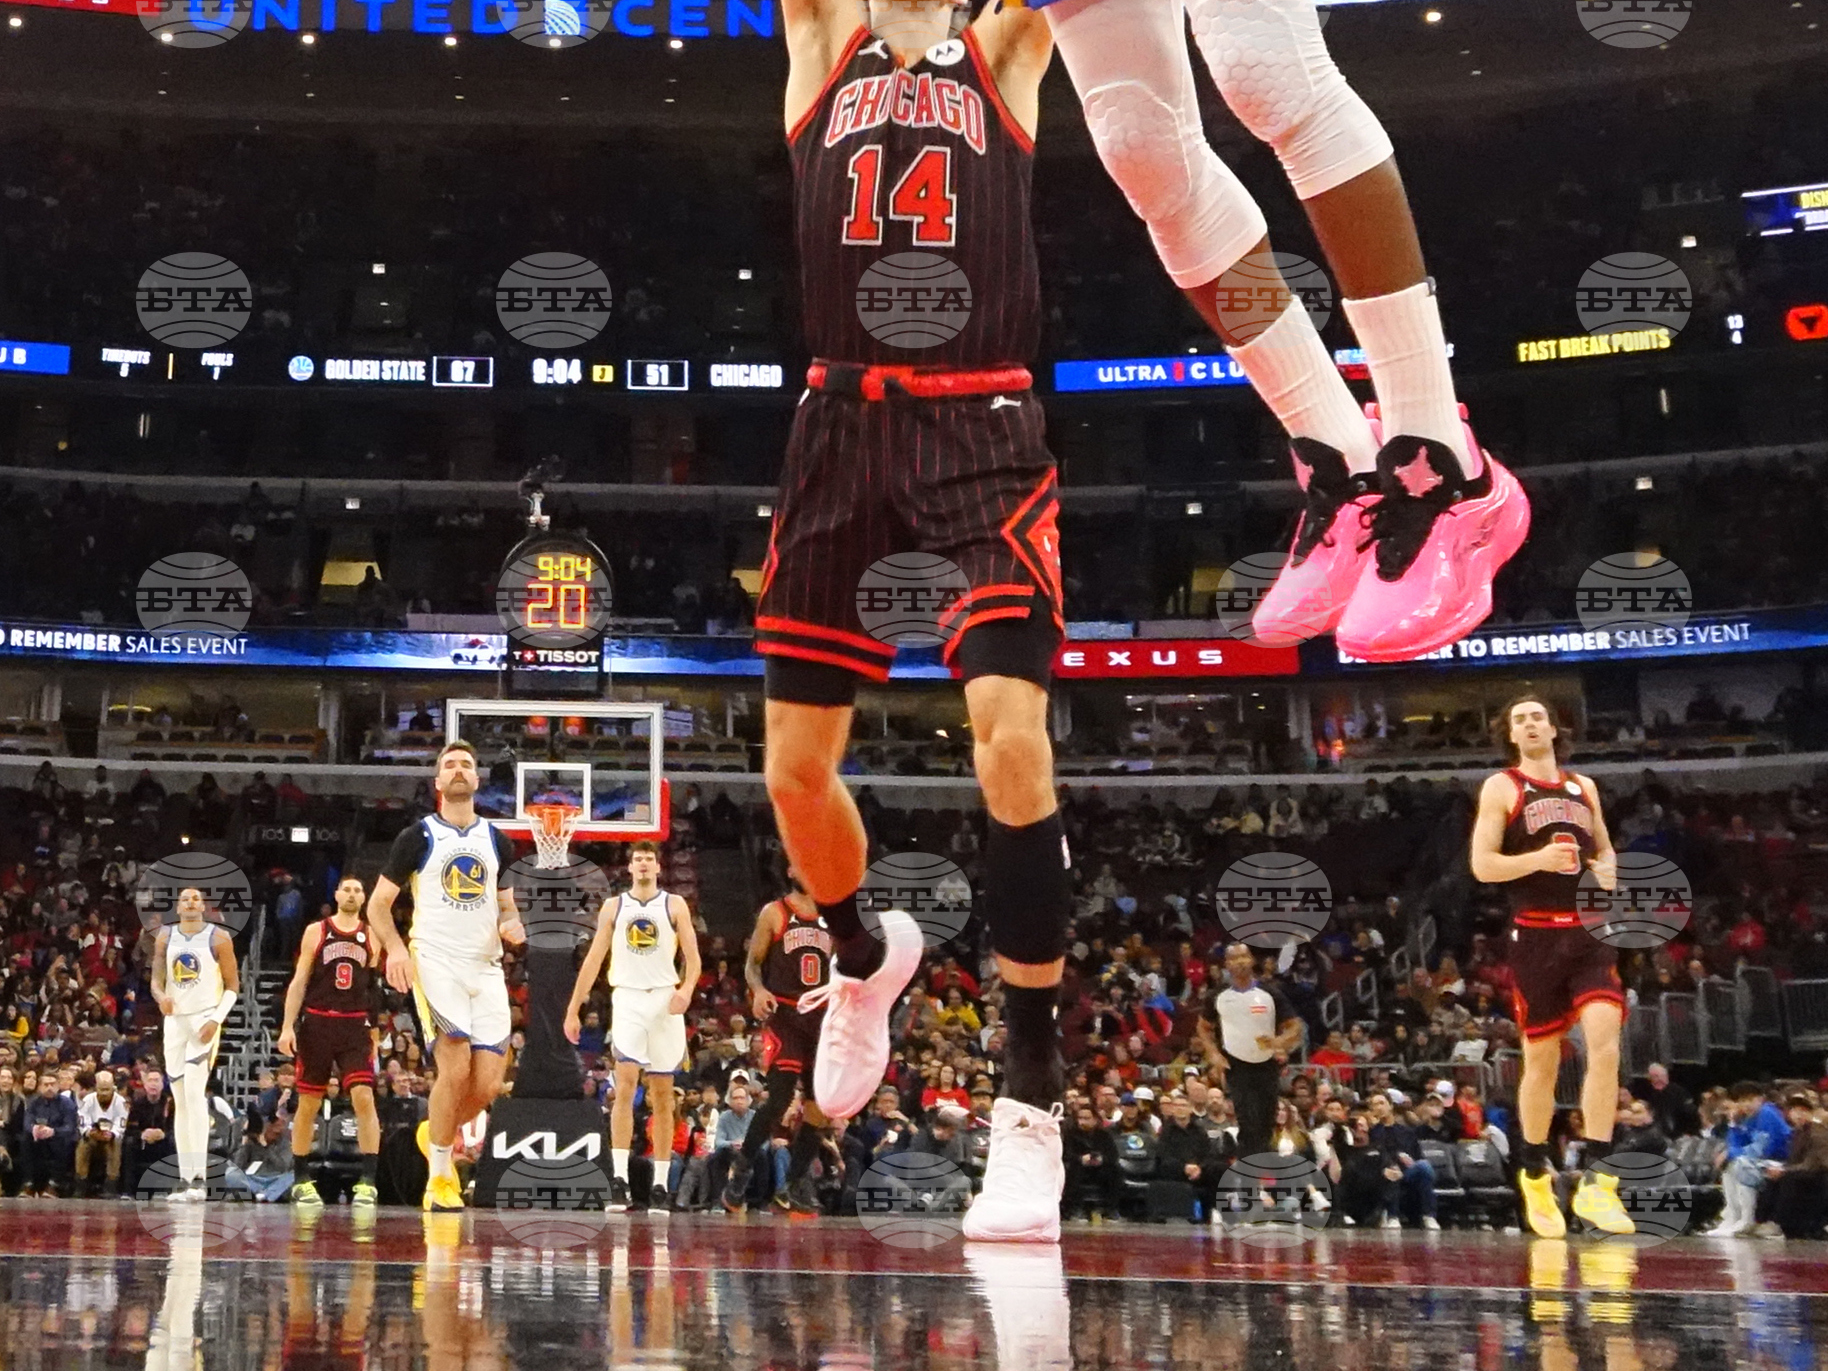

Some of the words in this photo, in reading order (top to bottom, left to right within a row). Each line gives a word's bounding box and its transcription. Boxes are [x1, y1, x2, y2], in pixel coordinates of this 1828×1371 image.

[824, 67, 986, 155] CHICAGO
[842, 144, 957, 247] 14
[1519, 340, 1556, 362] FAST
[1559, 334, 1611, 359] BREAK
[1612, 328, 1671, 353] POINTS
[325, 359, 381, 380] GOLDEN
[382, 360, 426, 380] STATE
[532, 358, 582, 384] 9:04
[645, 364, 669, 385] 51
[710, 364, 783, 388] CHICAGO
[1098, 364, 1167, 383] ULTRA
[1190, 361, 1246, 380] CLU
[538, 556, 592, 581] 9:04
[527, 584, 585, 628] 20
[10, 629, 121, 652] REMEMBER
[126, 636, 181, 654] SALES
[187, 638, 248, 655] EVENT
[1458, 638, 1487, 659] TO
[1492, 631, 1611, 656] REMEMBER
[1615, 627, 1677, 650] SALES
[1683, 622, 1750, 645] EVENT
[536, 650, 600, 663] TISSOT
[1063, 650, 1223, 666] EXUS
[470, 864, 482, 878] 61
[335, 962, 353, 989] 9
[801, 953, 821, 985] 0
